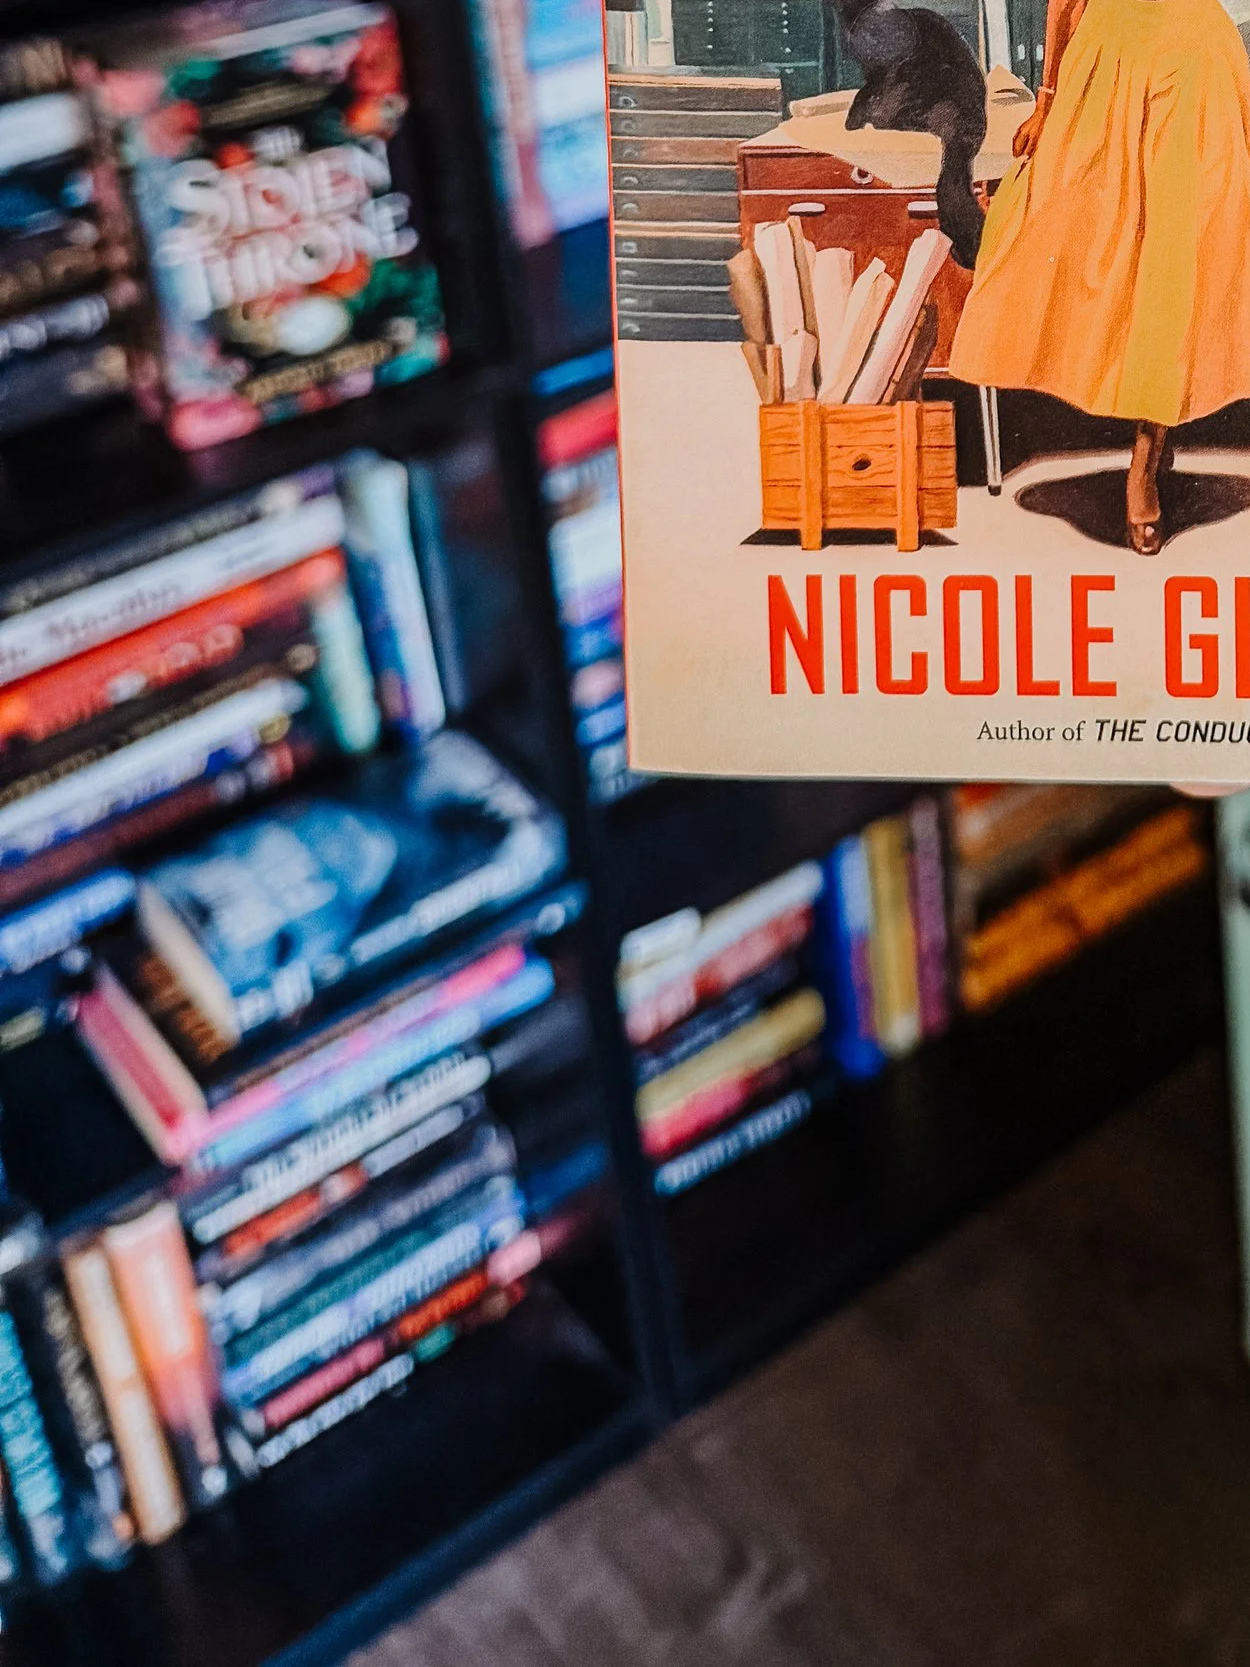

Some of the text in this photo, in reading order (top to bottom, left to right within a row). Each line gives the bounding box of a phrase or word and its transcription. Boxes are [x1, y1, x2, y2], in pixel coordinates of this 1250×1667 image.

[767, 574, 1118, 697] NICOLE
[976, 719, 1056, 742] Author
[1061, 720, 1087, 742] of
[1095, 718, 1148, 743] THE
